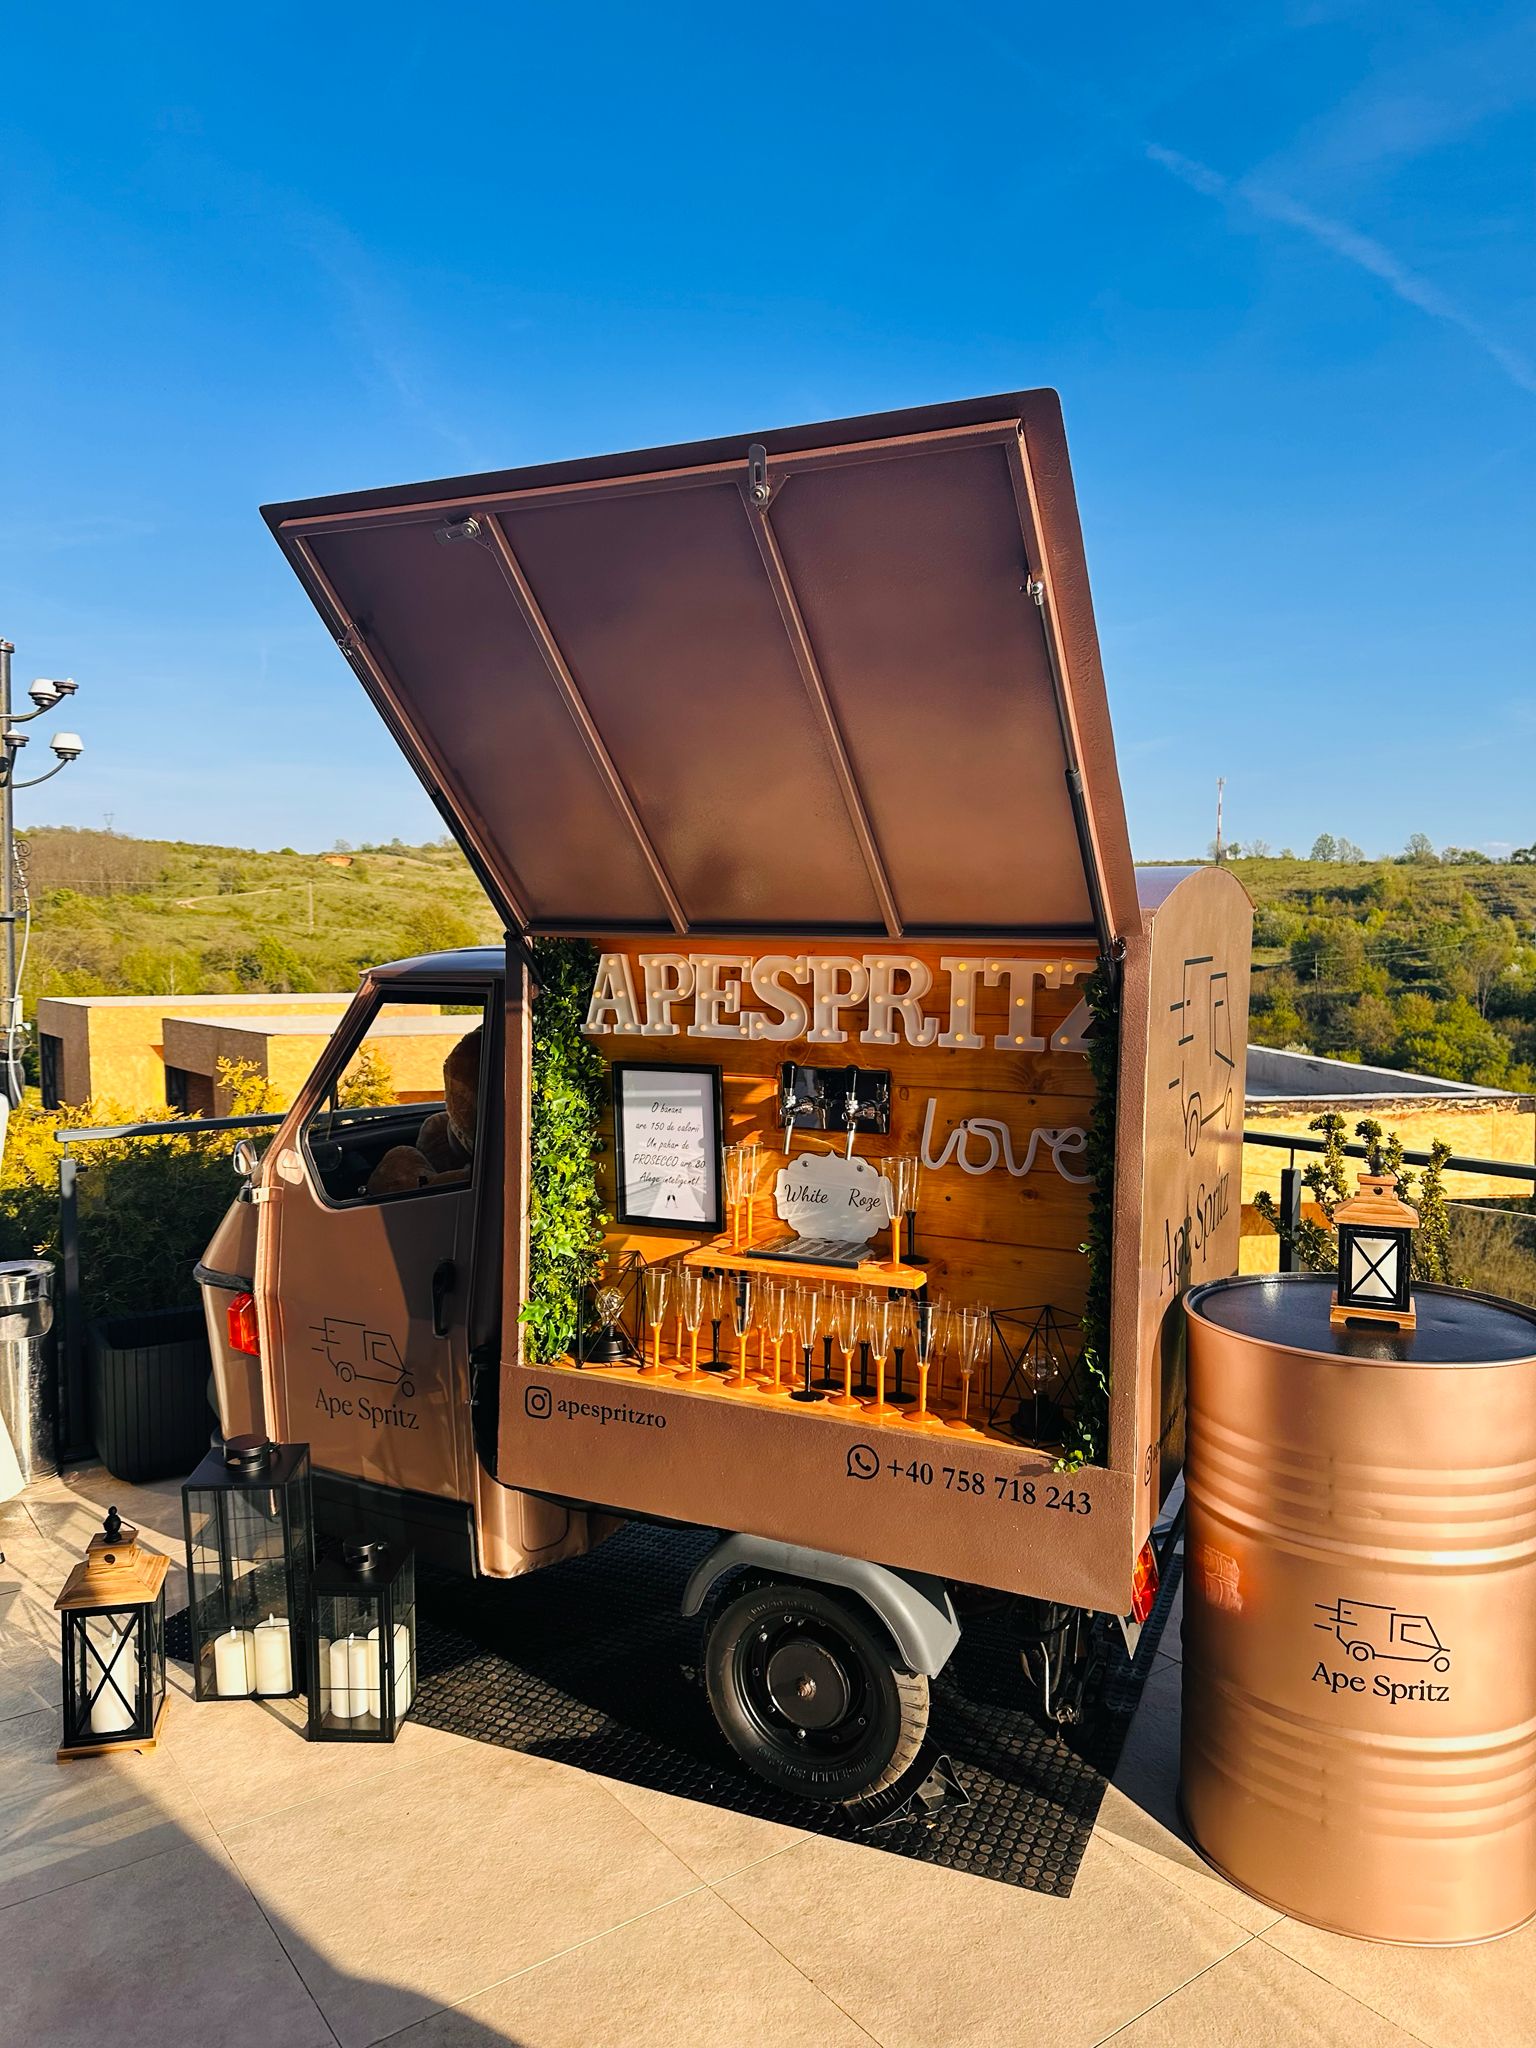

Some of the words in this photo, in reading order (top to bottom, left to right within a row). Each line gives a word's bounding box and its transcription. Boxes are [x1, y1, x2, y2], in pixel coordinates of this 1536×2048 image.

[651, 1101, 660, 1113] O
[660, 1103, 683, 1114] banana
[635, 1122, 647, 1130] are
[651, 1121, 665, 1131] 150
[666, 1121, 675, 1131] de
[677, 1121, 700, 1133] calorii
[921, 1098, 1095, 1184] love
[646, 1137, 657, 1149] Un
[658, 1140, 679, 1151] pahar
[681, 1140, 690, 1150] de
[632, 1153, 679, 1167] PROSECCO
[640, 1171, 660, 1186] Alege
[662, 1174, 700, 1188] inteligent!
[784, 1183, 829, 1204] White
[848, 1188, 881, 1212] Roze
[1159, 1216, 1192, 1298] Ape
[1195, 1165, 1229, 1264] Spritz
[315, 1387, 354, 1419] Ape
[358, 1397, 420, 1430] Spritz
[557, 1399, 667, 1428] apespritzro
[887, 1459, 934, 1486] +40
[942, 1467, 986, 1496] 758
[994, 1476, 1037, 1505] 718
[1045, 1486, 1092, 1515] 243
[1311, 1661, 1366, 1694] Ape
[1372, 1674, 1450, 1705] Spritz
